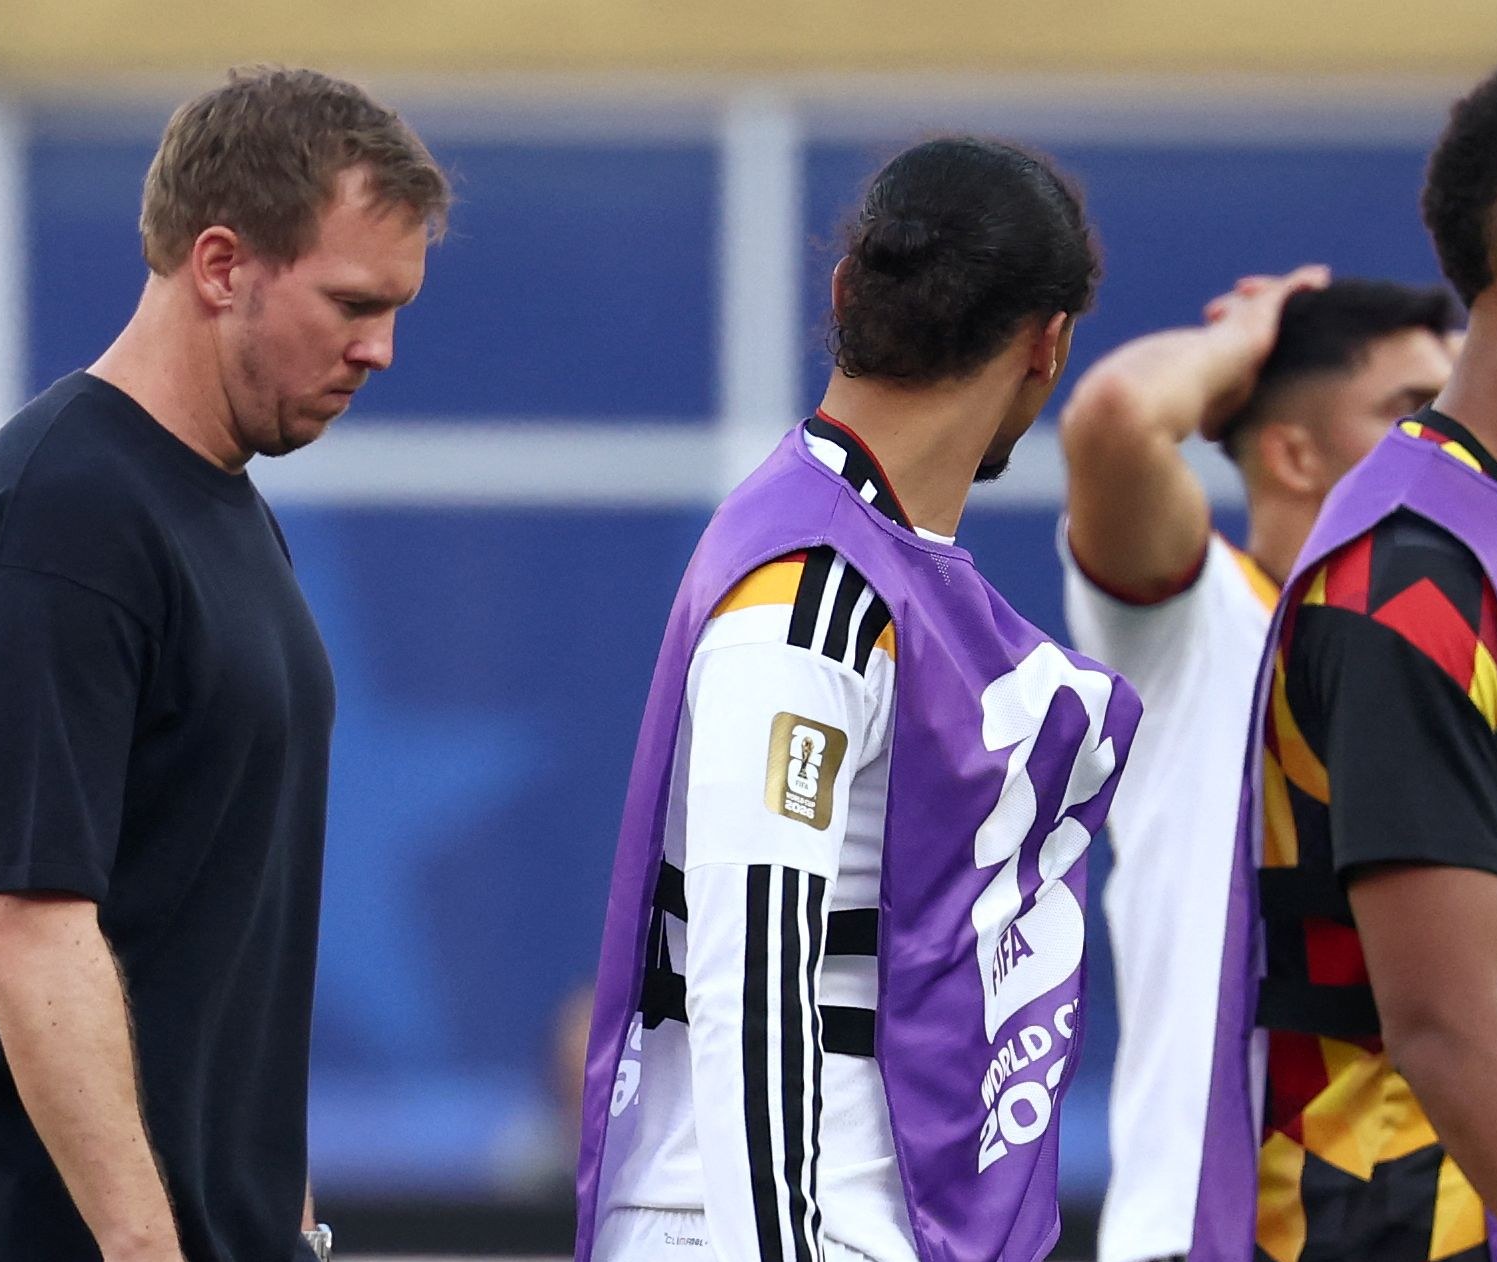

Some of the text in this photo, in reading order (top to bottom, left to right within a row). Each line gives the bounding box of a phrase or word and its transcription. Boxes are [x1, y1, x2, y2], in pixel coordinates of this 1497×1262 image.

[795, 780, 809, 790] FIFA
[992, 922, 1035, 998] FIFA
[980, 997, 1080, 1111] WORLD C
